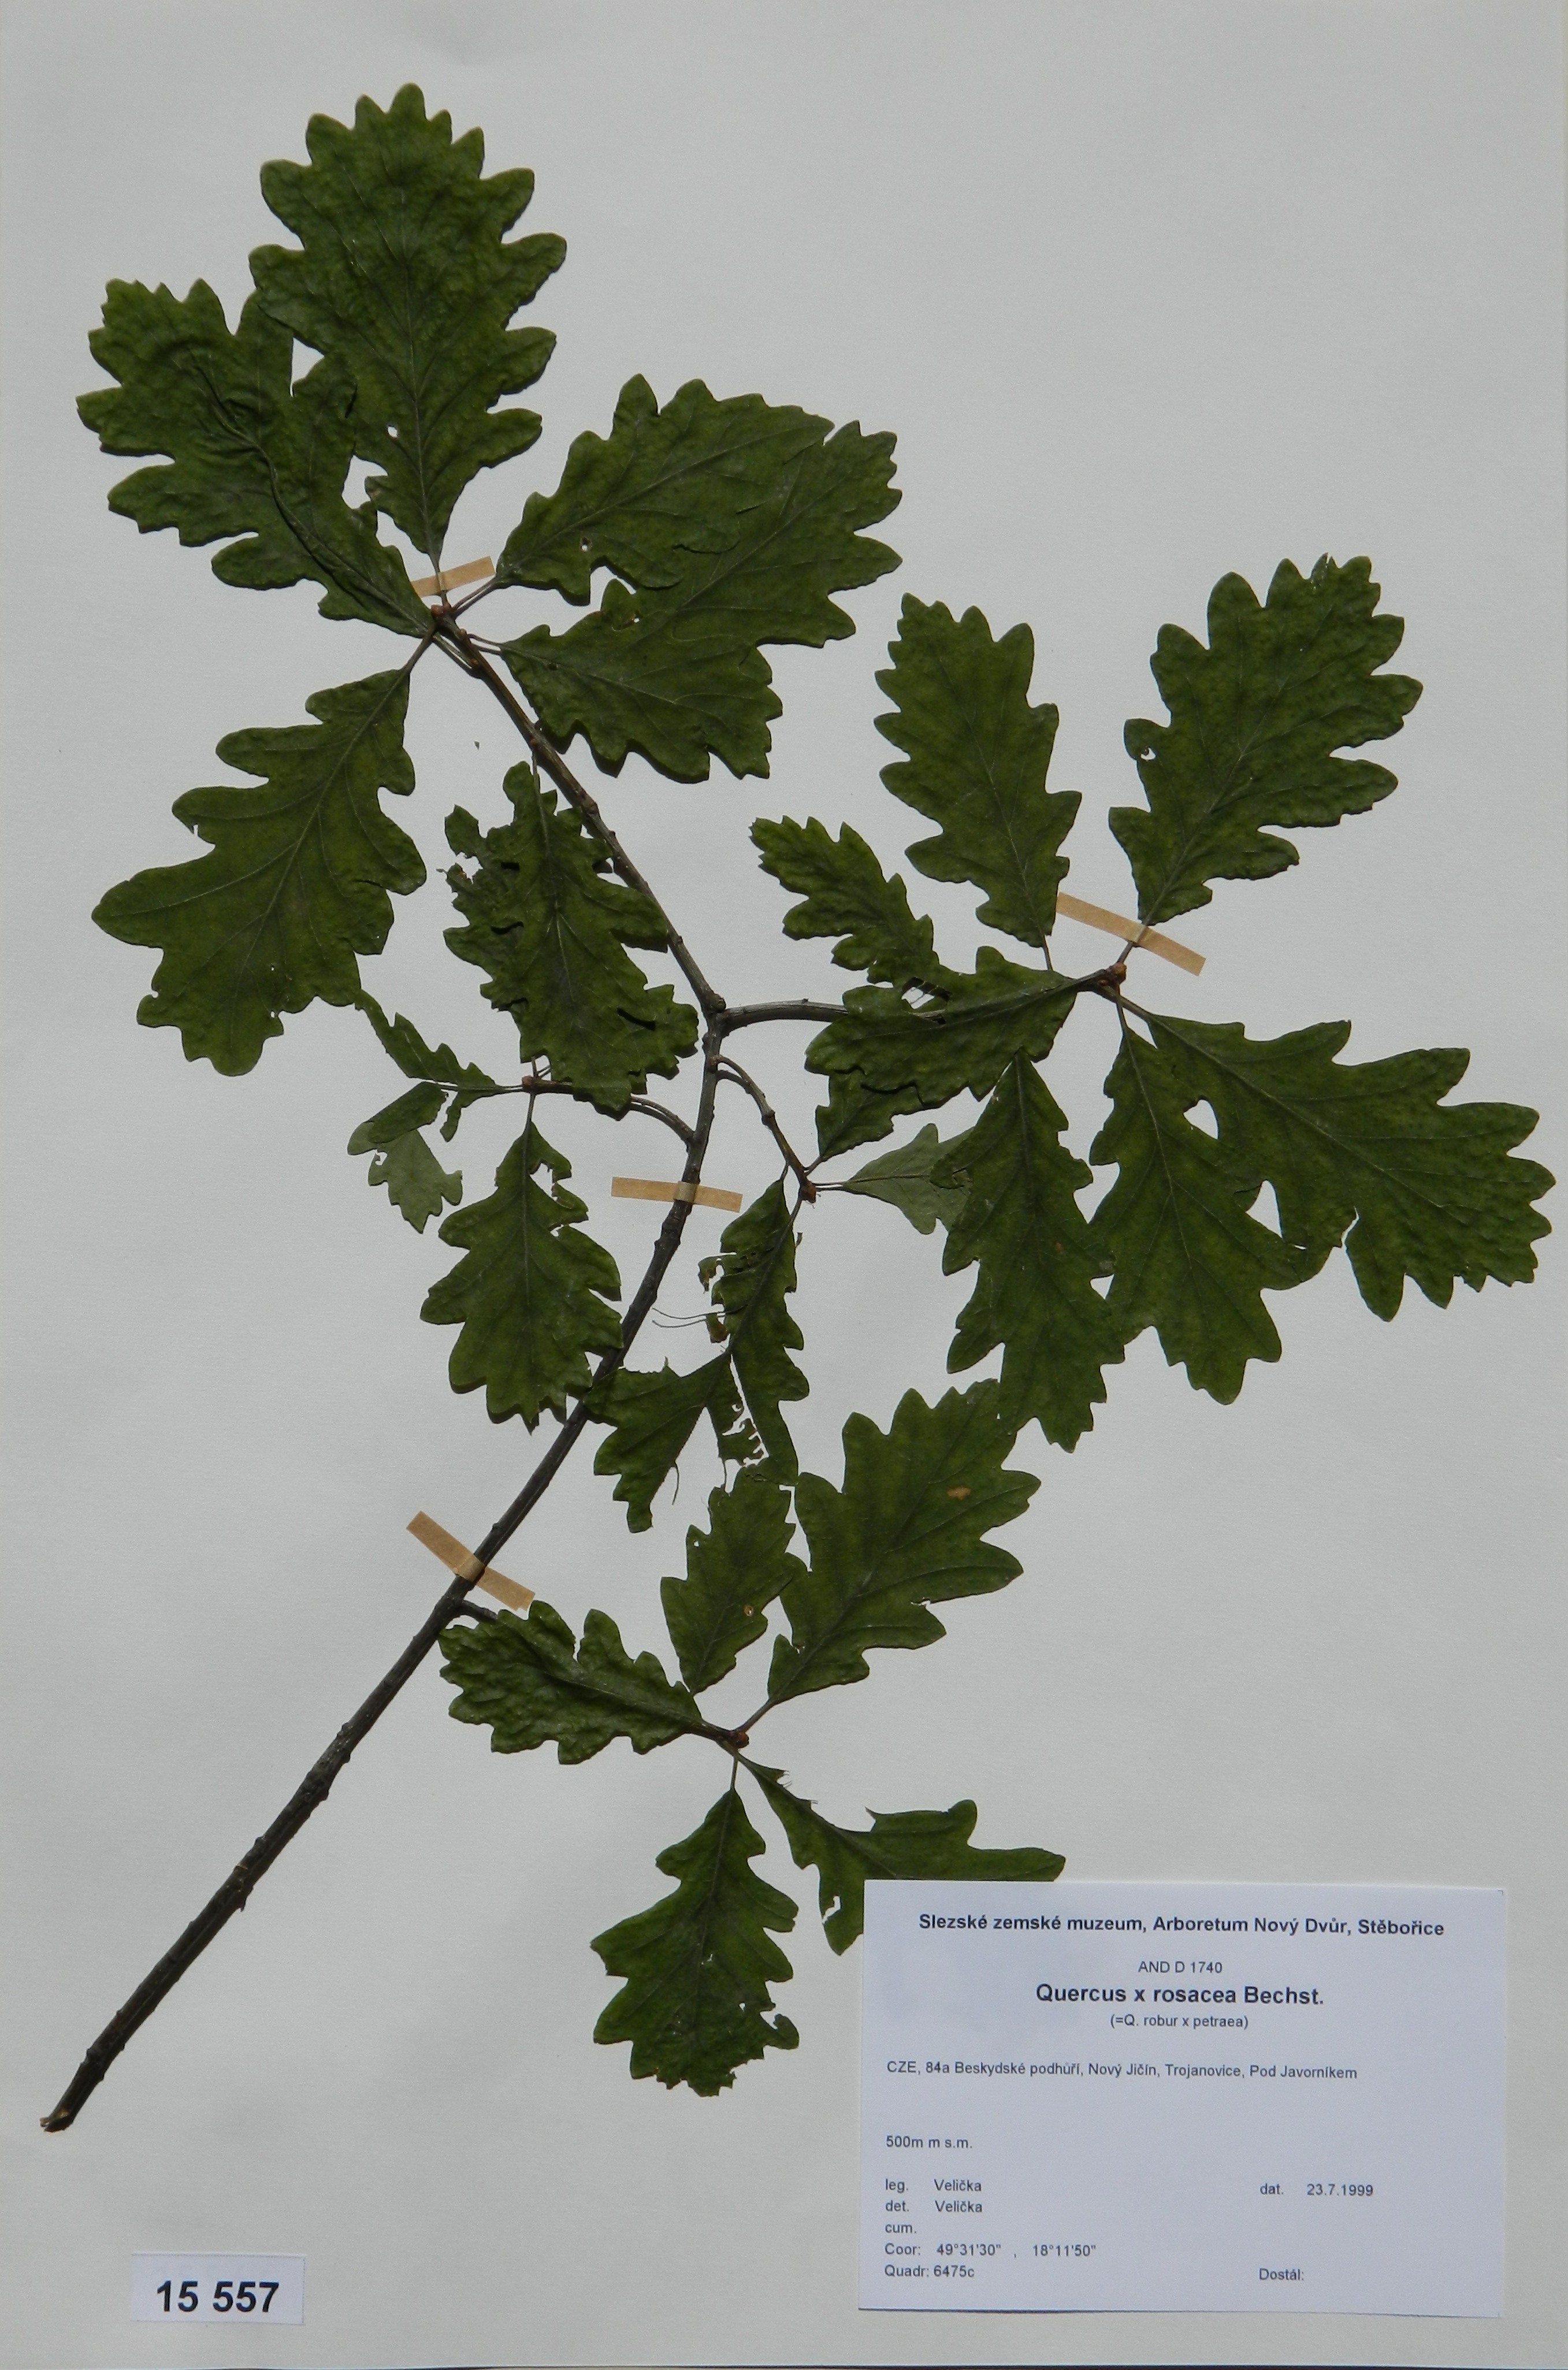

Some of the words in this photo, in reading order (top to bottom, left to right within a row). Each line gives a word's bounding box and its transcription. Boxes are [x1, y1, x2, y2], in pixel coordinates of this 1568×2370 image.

[919, 1914, 987, 1929] Slezské
[993, 1915, 1061, 1930] zemské
[1067, 1919, 1146, 1933] muzeum,
[1153, 1916, 1248, 1931] Arboretum
[1254, 1917, 1299, 1936] Nový
[1305, 1917, 1351, 1936] Dvůr,
[1358, 1919, 1444, 1936] Stěbořice
[1138, 1961, 1170, 1973] AND
[1175, 1961, 1185, 1973] D
[1191, 1961, 1223, 1974] 1740
[1036, 1983, 1127, 2003] Quercus
[1134, 1989, 1146, 2002] x
[1154, 1989, 1236, 2003] rosacea
[1244, 1986, 1324, 2005] Bechst.
[1110, 2014, 1139, 2029] (=Q.
[1144, 2014, 1178, 2026] robur
[1182, 2018, 1189, 2026] x
[1193, 2015, 1249, 2030] petraea)
[887, 2061, 920, 2075] CZE,
[926, 2061, 949, 2074] 84a
[955, 2061, 1025, 2077] Beskydské
[1030, 2062, 1083, 2077] podhůří,
[1088, 2063, 1122, 2078] Nový
[1126, 2063, 1160, 2078] Jičín,
[1165, 2064, 1244, 2079] Trojanovice,
[1250, 2065, 1276, 2078] Pod
[1280, 2066, 1357, 2079] Javorníkem
[886, 2135, 923, 2148] 500m
[928, 2139, 940, 2148] m
[945, 2139, 972, 2149] s.m.
[885, 2178, 908, 2193] leg.
[934, 2179, 982, 2192] Velička
[1259, 2183, 1283, 2196] dat.
[1307, 2183, 1373, 2197] 23.7.1999
[885, 2200, 909, 2212] det.
[935, 2200, 982, 2213] Velička
[885, 2224, 916, 2234] cum.
[885, 2242, 920, 2256] Coor:
[885, 2264, 929, 2278] Quadr:
[934, 2265, 974, 2278] 6475c
[1259, 2268, 1304, 2281] Dostál:
[157, 2280, 199, 2313] 15
[213, 2280, 280, 2313] 557
